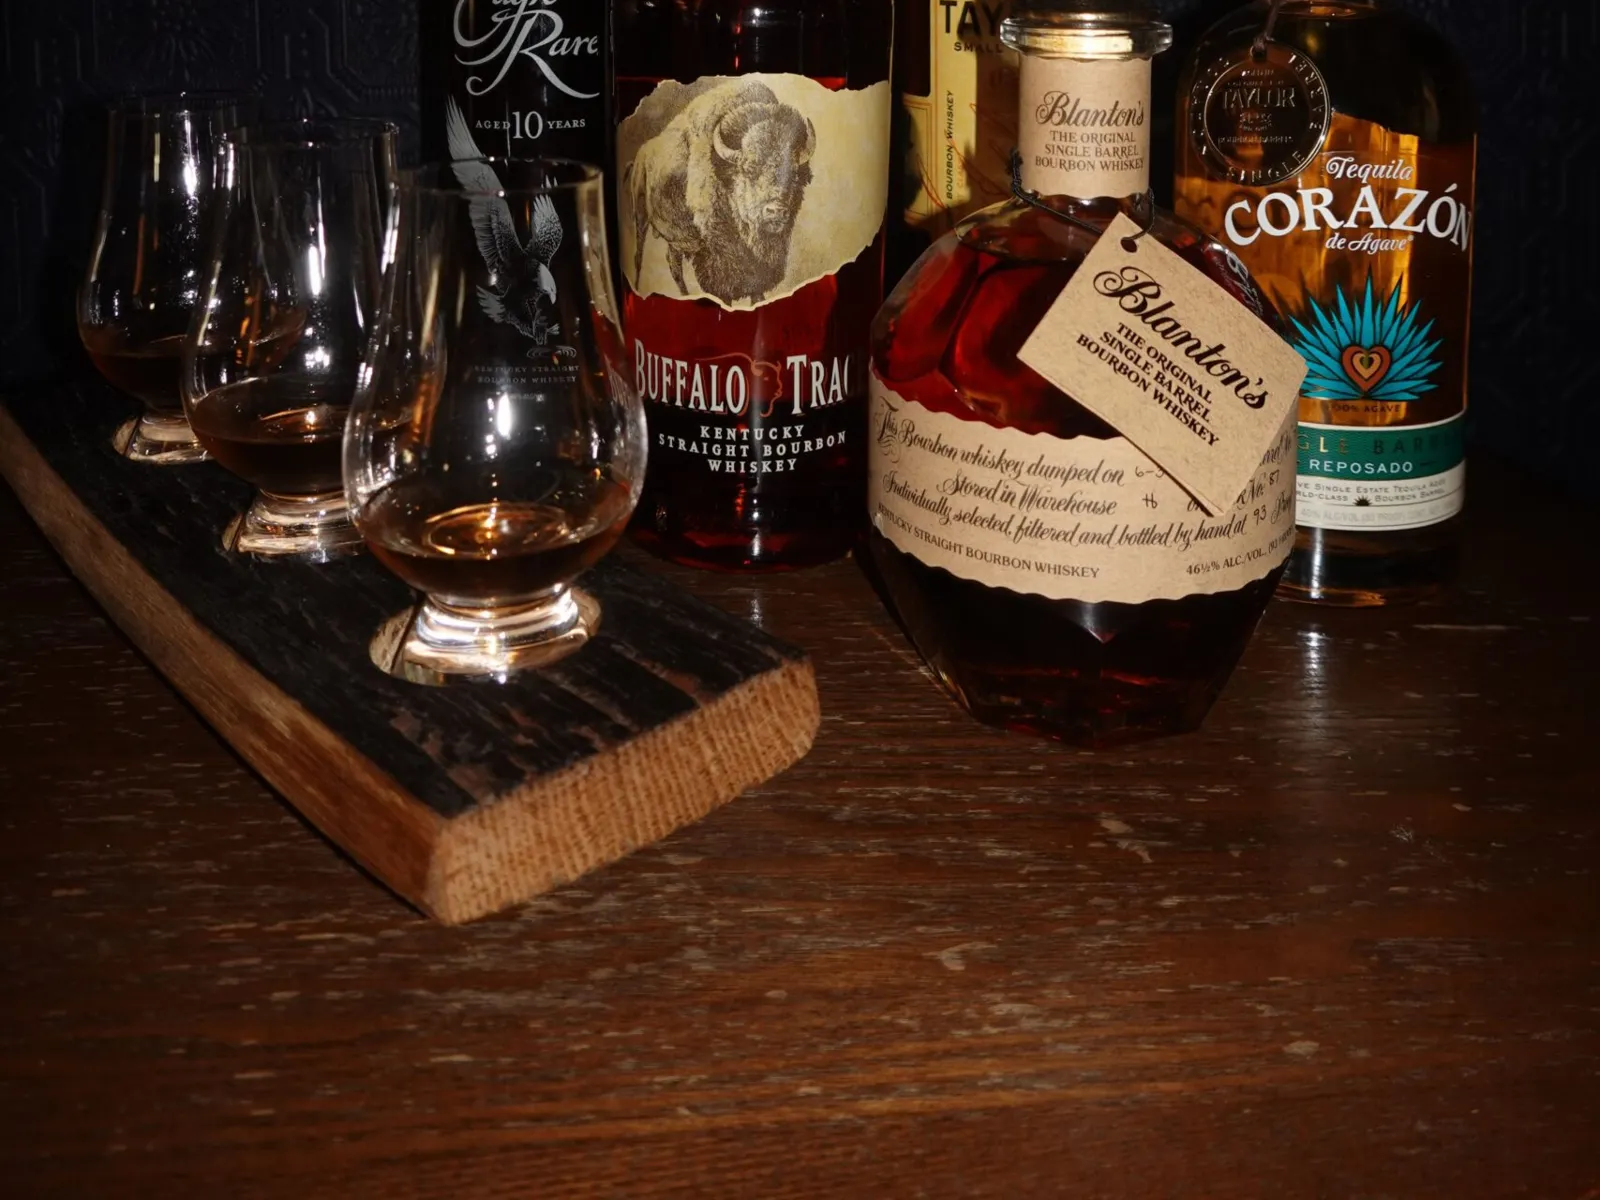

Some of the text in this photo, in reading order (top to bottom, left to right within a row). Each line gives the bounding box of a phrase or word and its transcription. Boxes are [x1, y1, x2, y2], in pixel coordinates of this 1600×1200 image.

[939, 0, 1004, 38] TAY
[466, 8, 601, 99] Rare
[954, 42, 1003, 54] SMALL
[1035, 90, 1145, 127] Blanton's
[1223, 87, 1296, 109] TAYLOR
[475, 110, 586, 140] AGED 10 YEARS
[1050, 130, 1136, 146] THE ORIGINAL
[945, 89, 955, 200] BOURBON WHISKEY
[1045, 144, 1139, 161] SINGLE BARREL
[1035, 156, 1145, 172] BOURBON WHISKEY
[1325, 156, 1414, 184] Tequila
[1224, 182, 1472, 253] CORAZÓN
[1325, 232, 1345, 251] de
[1093, 266, 1269, 410] Blanton's
[634, 337, 850, 416] BUFFALO TRA
[1100, 331, 1212, 422] SINGLE BARREL
[1115, 322, 1213, 404] THE ORIGINAL
[1076, 334, 1220, 447] BOURBON WHISKEY
[658, 430, 847, 458] STRAIGHT BOURBON
[700, 424, 805, 441] KENTUCKY
[1297, 433, 1350, 455] GLE
[707, 458, 798, 474] WHISKEY
[899, 419, 959, 462] Bourbon
[961, 444, 1025, 481] whiskey
[1027, 454, 1104, 488] dumped
[1102, 468, 1125, 486] on
[1309, 458, 1414, 475] REPOSADO
[936, 469, 1003, 500] Stored
[1001, 488, 1018, 508] in
[1008, 481, 1118, 515] Warehouse
[1296, 490, 1349, 502] RLD-CLASS
[1314, 483, 1351, 493] SINGLE
[1356, 485, 1389, 494] ESTATE
[882, 470, 952, 526] Individually
[1014, 515, 1079, 546] filtered
[1078, 524, 1118, 549] and
[1117, 522, 1175, 548] bottled
[1172, 522, 1193, 552] by
[1194, 513, 1236, 542] hand
[1232, 513, 1248, 536] at
[1253, 504, 1267, 526] 93
[877, 502, 1100, 579] KENTUCKY STRAIGHT BOURBON WHISKEY
